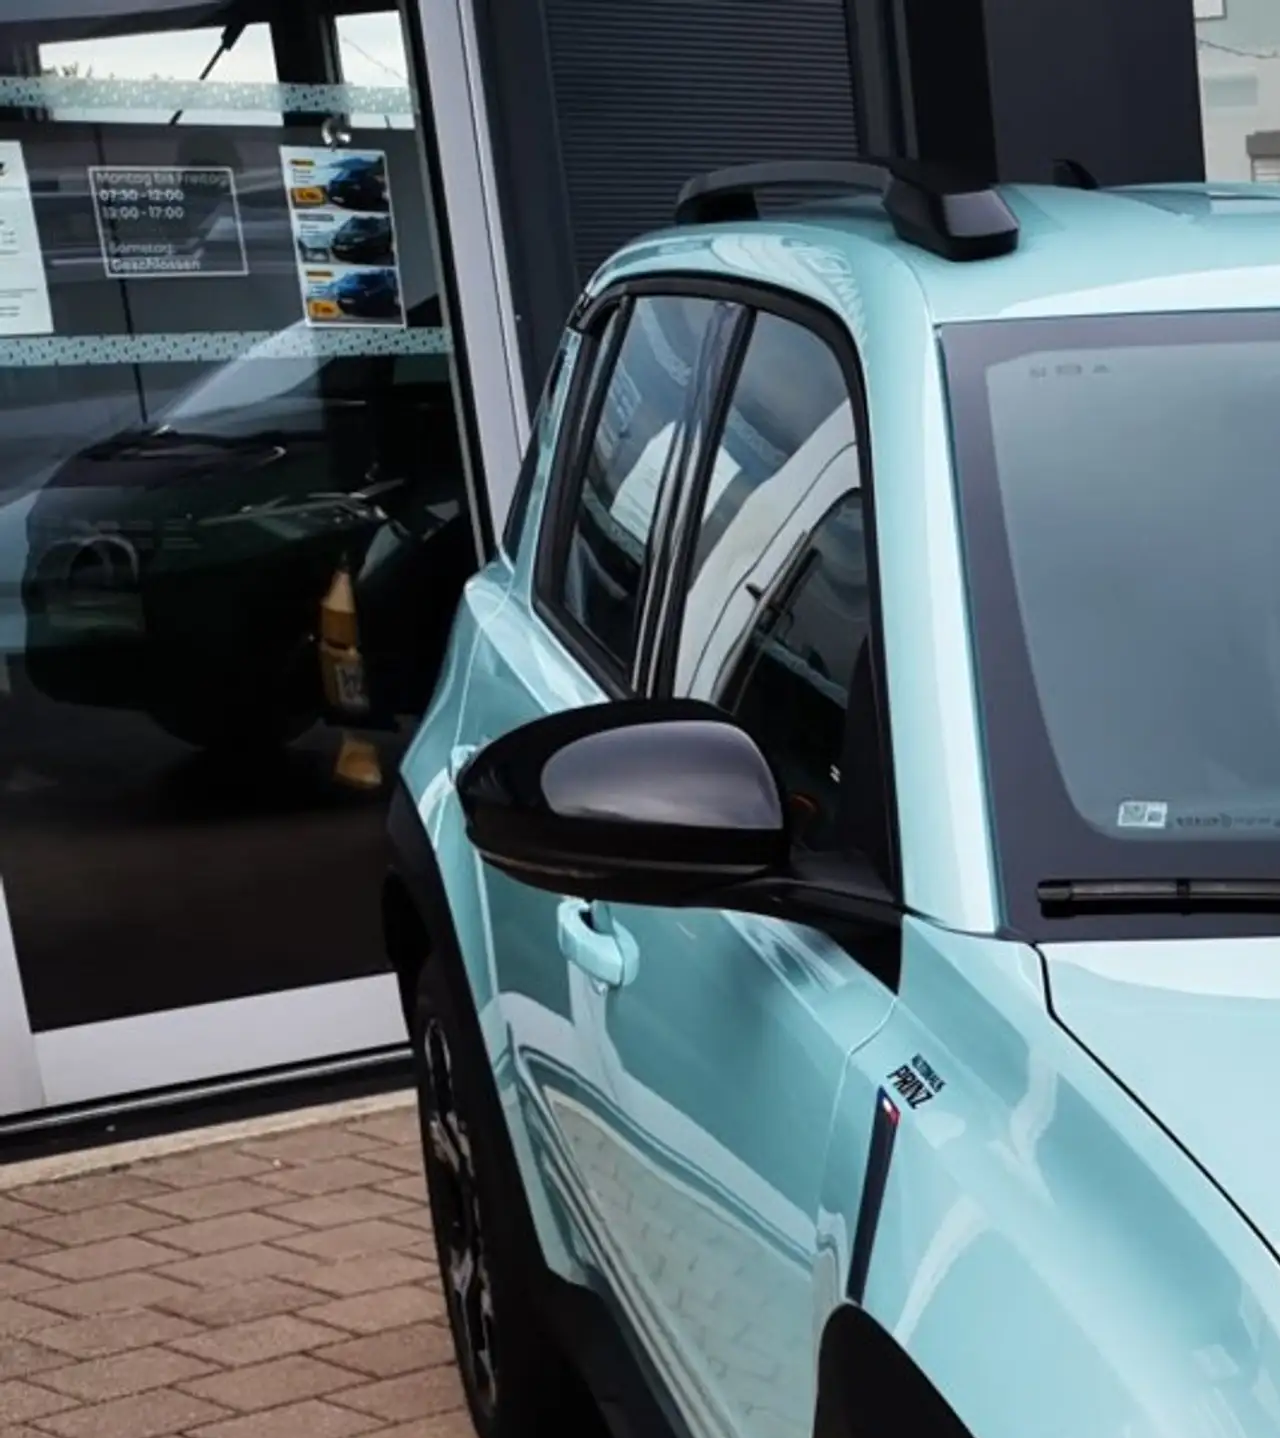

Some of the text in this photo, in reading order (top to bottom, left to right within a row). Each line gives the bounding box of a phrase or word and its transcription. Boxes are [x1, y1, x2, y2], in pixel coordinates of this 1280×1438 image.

[97, 172, 151, 187] Montag
[100, 188, 138, 202] 07:30
[148, 188, 184, 202] 12:00
[102, 205, 139, 219] 13:00
[149, 205, 184, 219] 17:00
[886, 1064, 933, 1110] PRINZ
